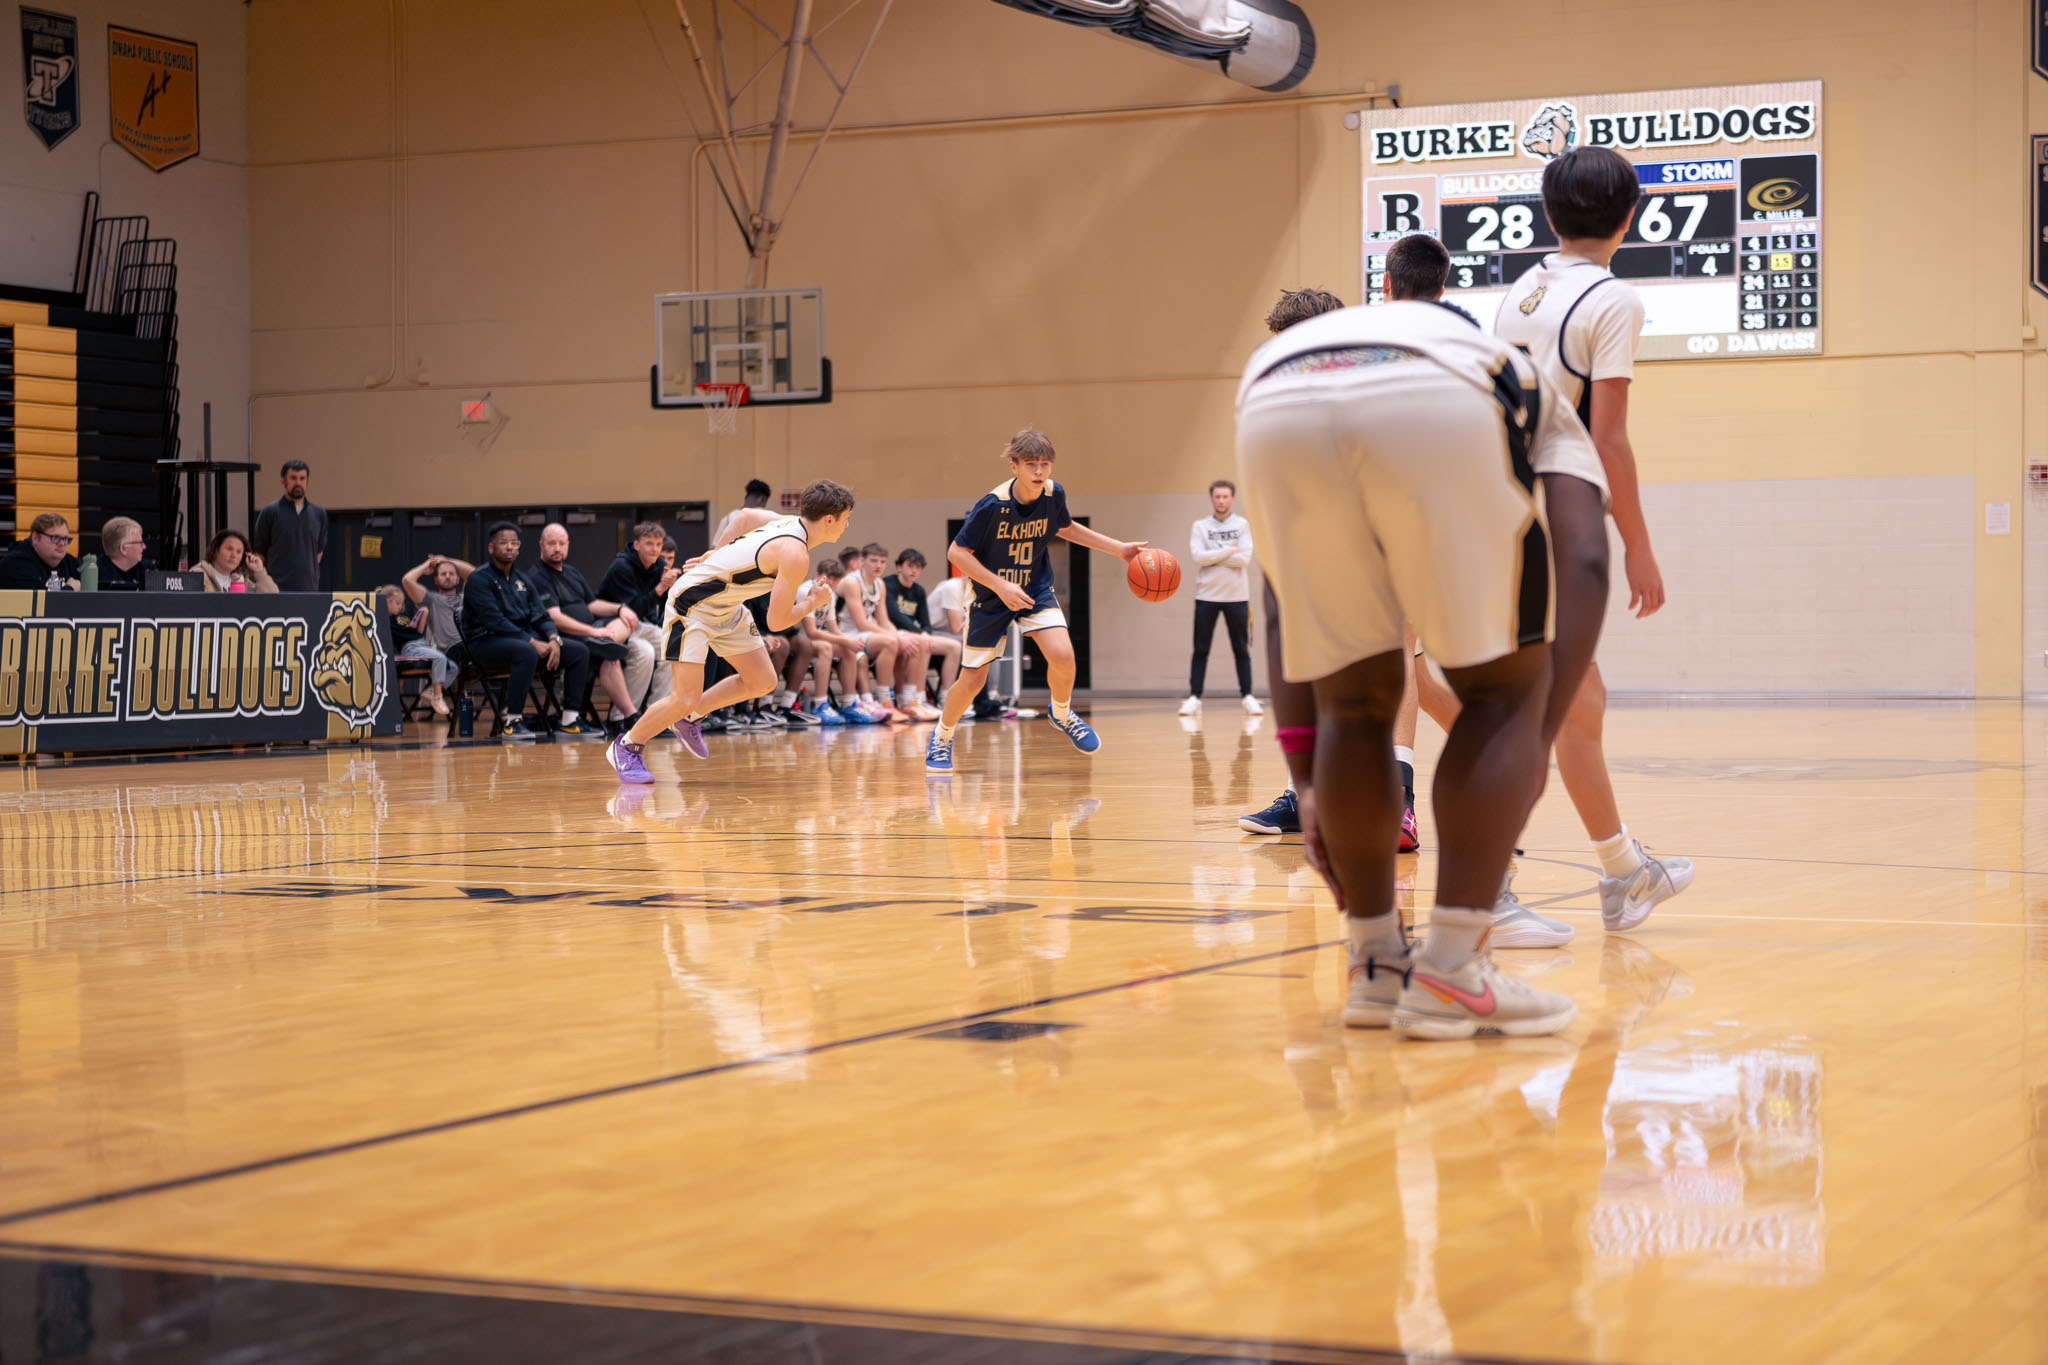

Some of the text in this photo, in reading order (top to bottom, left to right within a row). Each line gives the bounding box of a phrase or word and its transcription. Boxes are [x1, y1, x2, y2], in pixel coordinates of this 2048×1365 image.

[1375, 103, 1813, 161] BURKE BULLDOGS
[1662, 158, 1734, 183] STORM
[1380, 193, 1423, 231] B
[1638, 194, 1709, 243] 67
[1767, 209, 1804, 221] MILLER
[1466, 204, 1534, 252] 28
[1688, 243, 1731, 256] FOULS
[1748, 235, 1811, 251] 4 1 1
[1701, 256, 1718, 277] 4
[1748, 255, 1761, 271] 3
[1801, 254, 1812, 267] 0
[1458, 268, 1473, 288] 3
[1743, 273, 1812, 291] 24 11 1
[1744, 293, 1812, 310] 21 7 0
[1743, 312, 1812, 330] 35 7 0
[1687, 332, 1817, 353] GO DAWGS!
[1008, 541, 1034, 566] 40
[165, 576, 184, 591] POSS.
[0, 623, 306, 719] BURKE BULLDOGS
